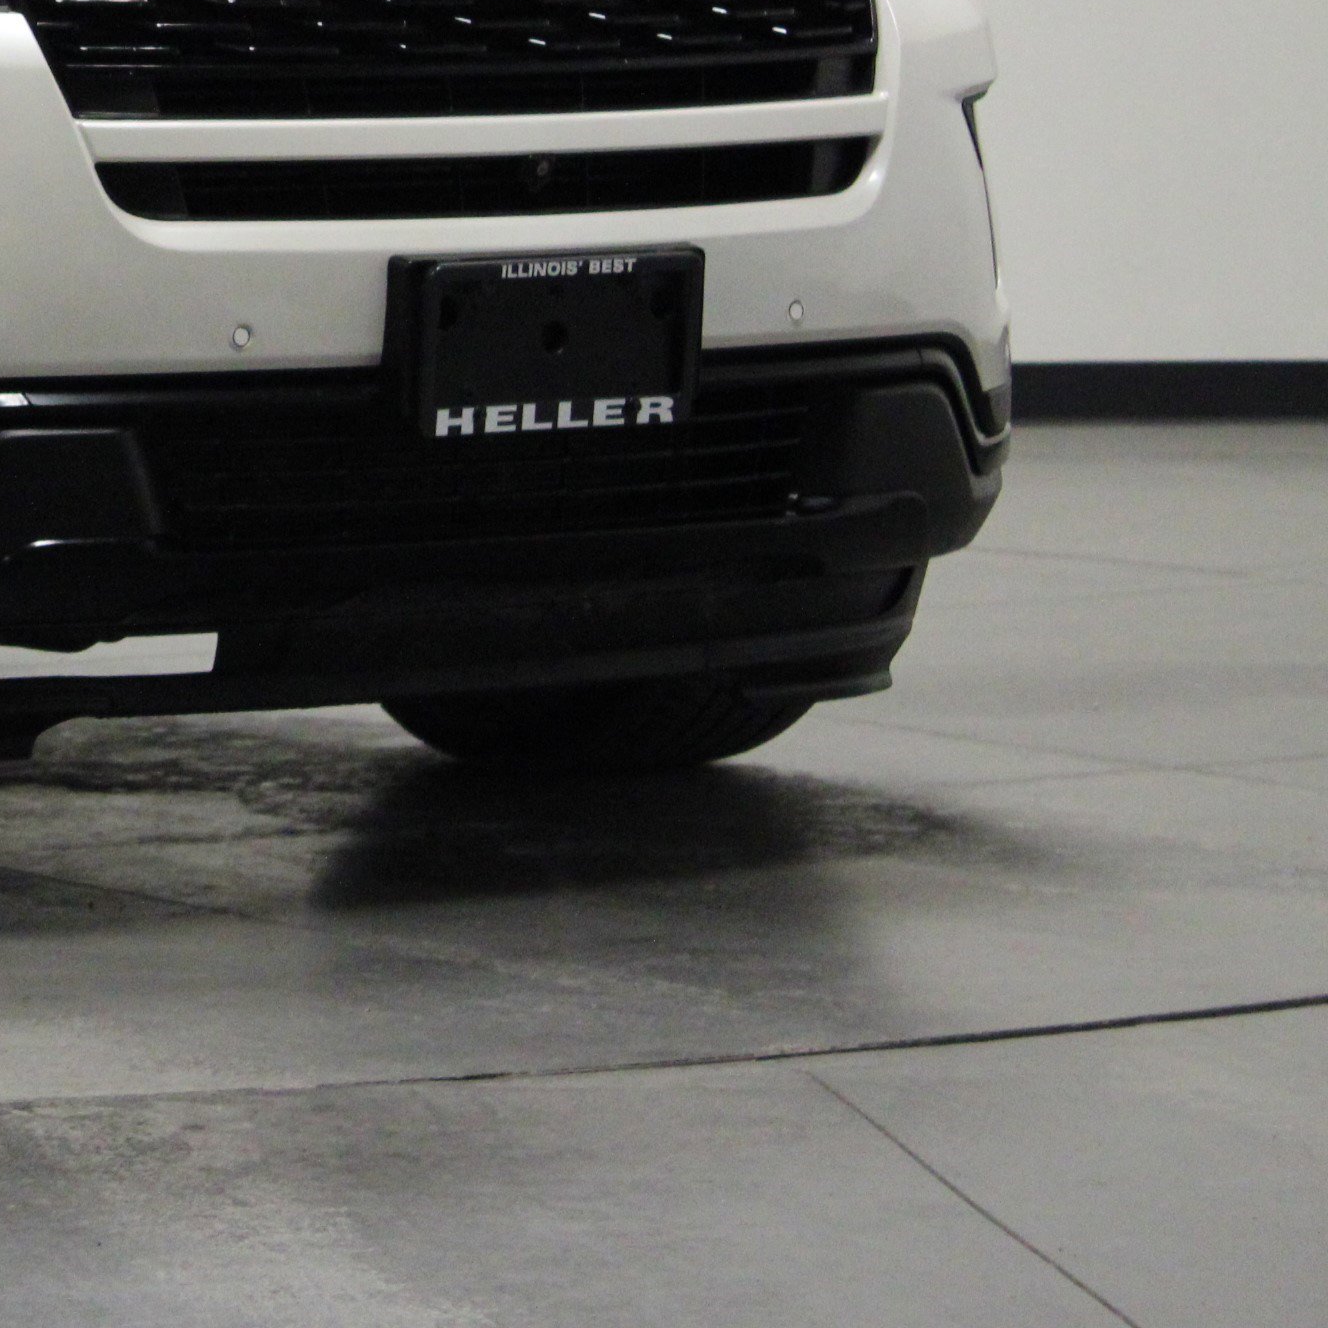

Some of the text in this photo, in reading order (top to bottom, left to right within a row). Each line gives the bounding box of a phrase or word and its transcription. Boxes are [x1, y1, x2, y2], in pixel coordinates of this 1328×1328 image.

[500, 257, 637, 279] ILLINOIS' BEST
[434, 395, 675, 437] HELLER
